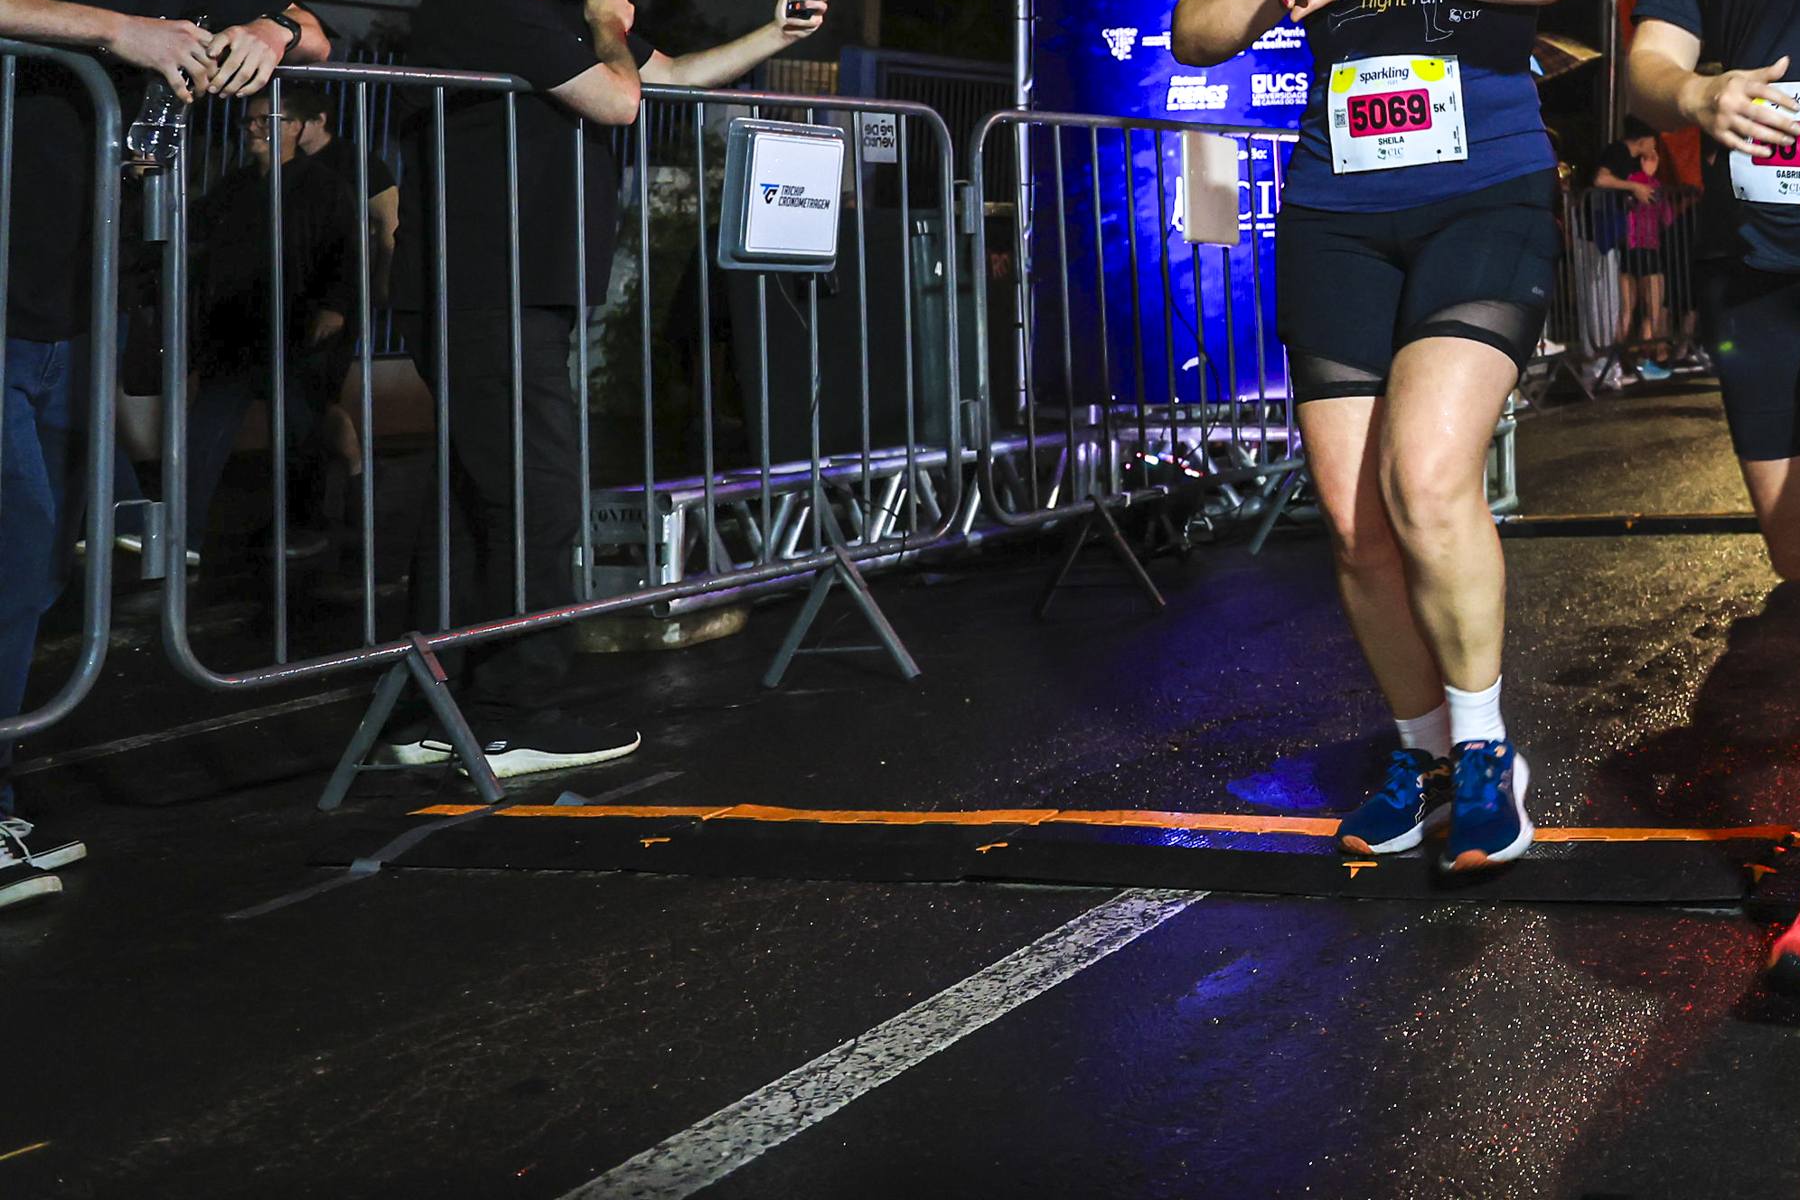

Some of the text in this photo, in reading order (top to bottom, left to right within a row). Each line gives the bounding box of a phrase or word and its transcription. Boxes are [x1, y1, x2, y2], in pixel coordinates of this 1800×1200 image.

[1266, 73, 1308, 91] UCS
[1360, 67, 1409, 85] sparkling
[1351, 94, 1427, 131] 5069
[1433, 103, 1446, 113] 5K
[1378, 136, 1405, 146] SHEILA
